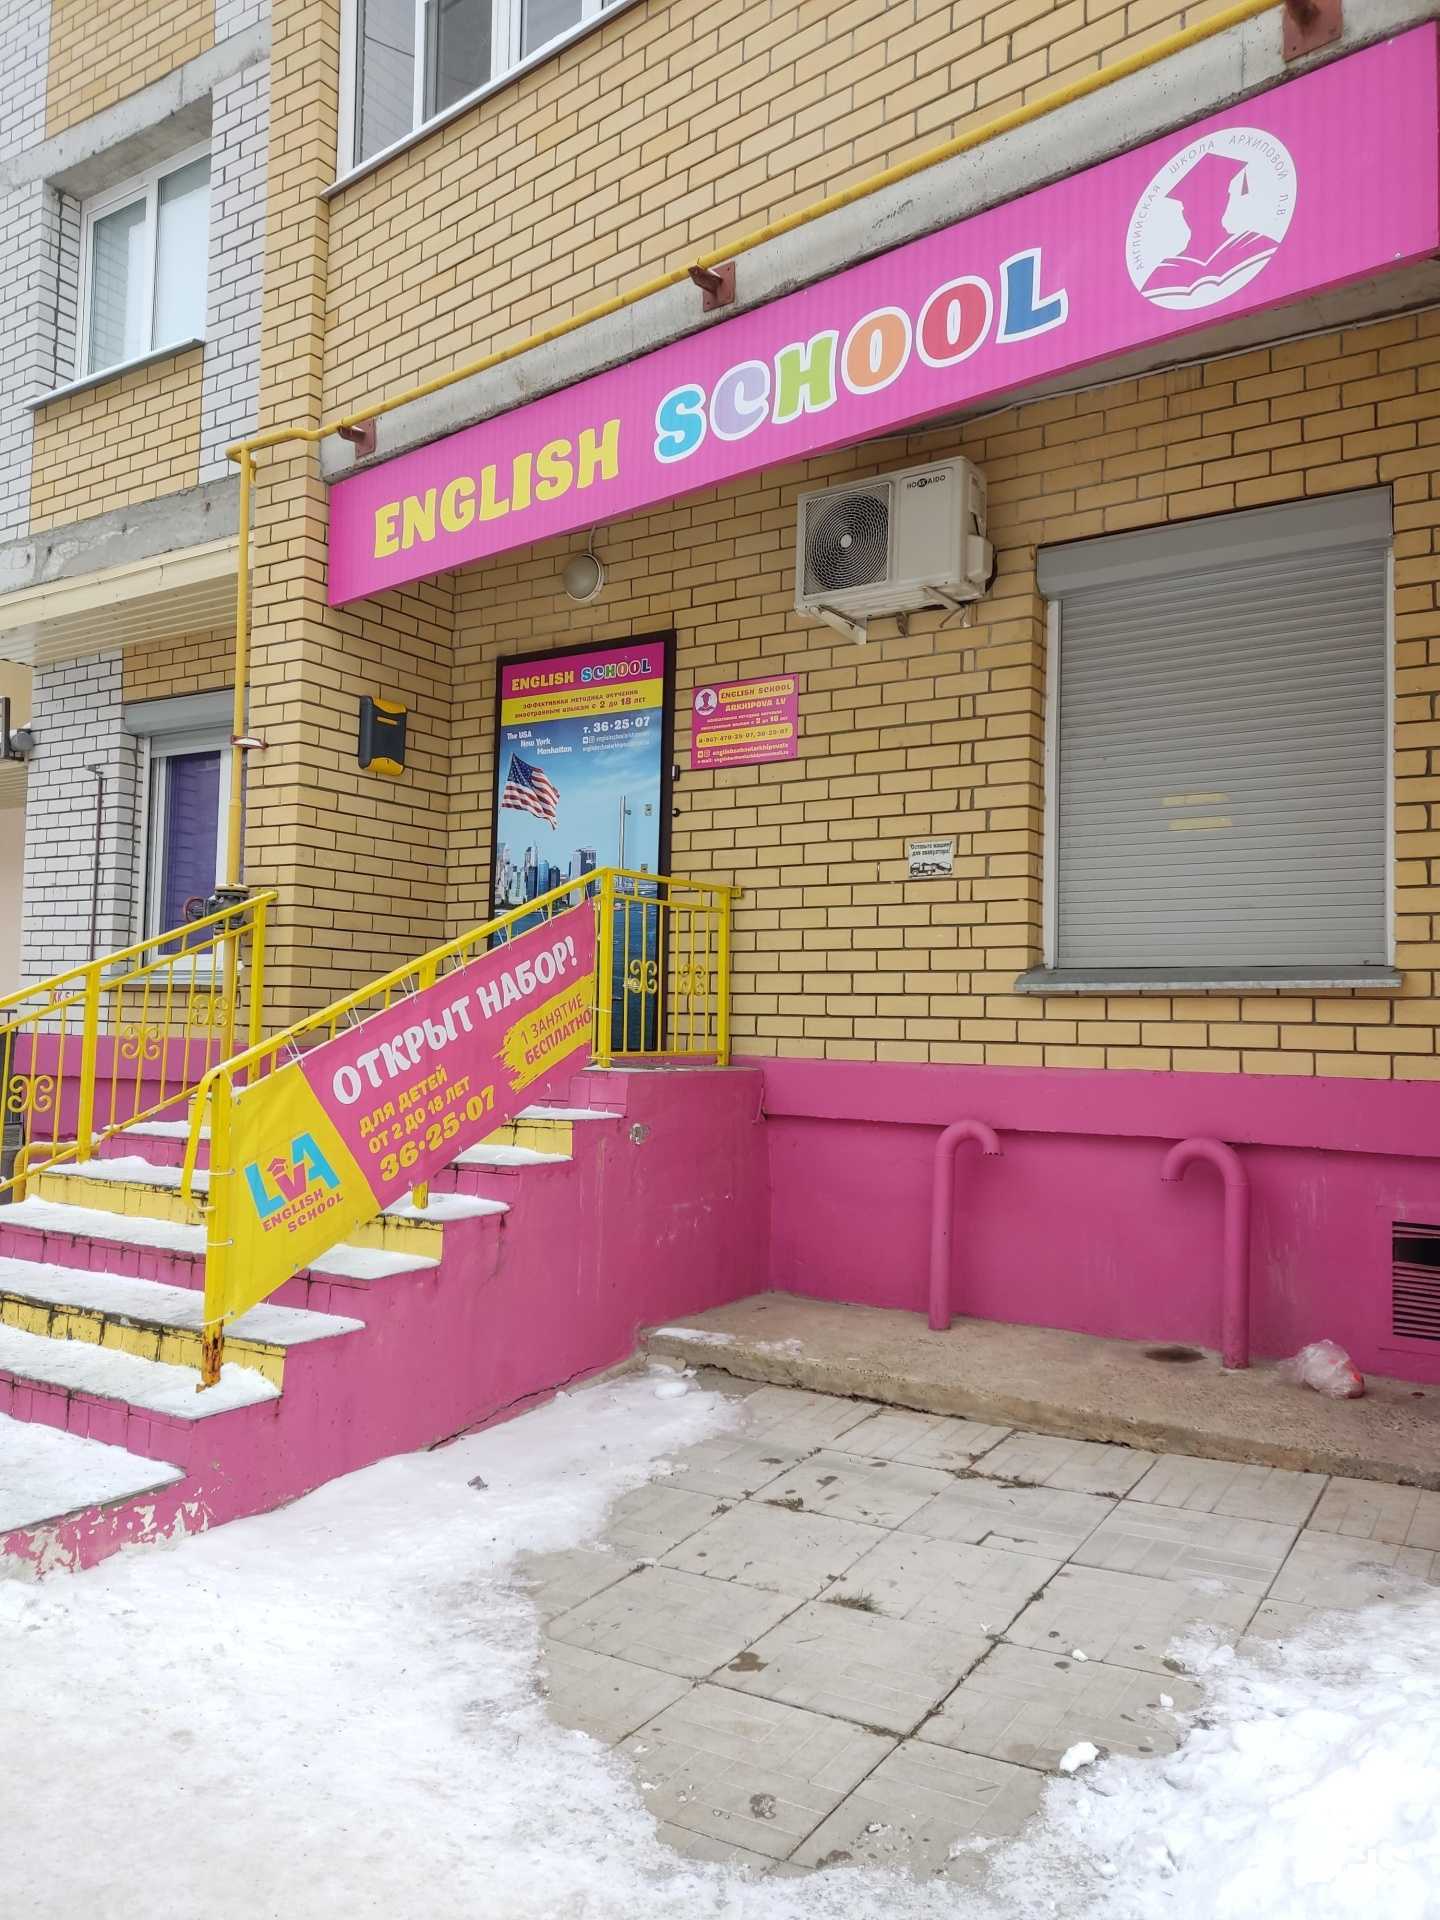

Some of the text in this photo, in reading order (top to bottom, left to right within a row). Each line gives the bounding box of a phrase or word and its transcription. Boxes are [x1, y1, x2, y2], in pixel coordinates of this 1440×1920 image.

[1168, 140, 1215, 175] ШКОЛА
[1229, 134, 1288, 180] АРХИПОВОЙ
[373, 247, 1069, 559] ENGLISH SCHOOL
[511, 658, 652, 691] ENGLISH SCHOOL
[721, 683, 792, 699] ENGLISH SCHOOL
[621, 697, 632, 706] 18
[518, 730, 532, 739] USA
[520, 737, 552, 748] New York
[536, 746, 573, 755] Manhattan
[332, 935, 578, 1105] ОТКРЫТ НАБОР!
[520, 991, 584, 1045] 1 ЗАНЯТИЕ
[524, 1008, 592, 1066] БЕСПЛАТНО
[359, 1063, 448, 1138] ДЛЯ ДЕТЕЙ
[368, 1075, 471, 1154] ОТ 2 ДО 18 ЛЕТ
[261, 1187, 324, 1233] ENGLISH
[287, 1191, 344, 1233] SCHOOL
